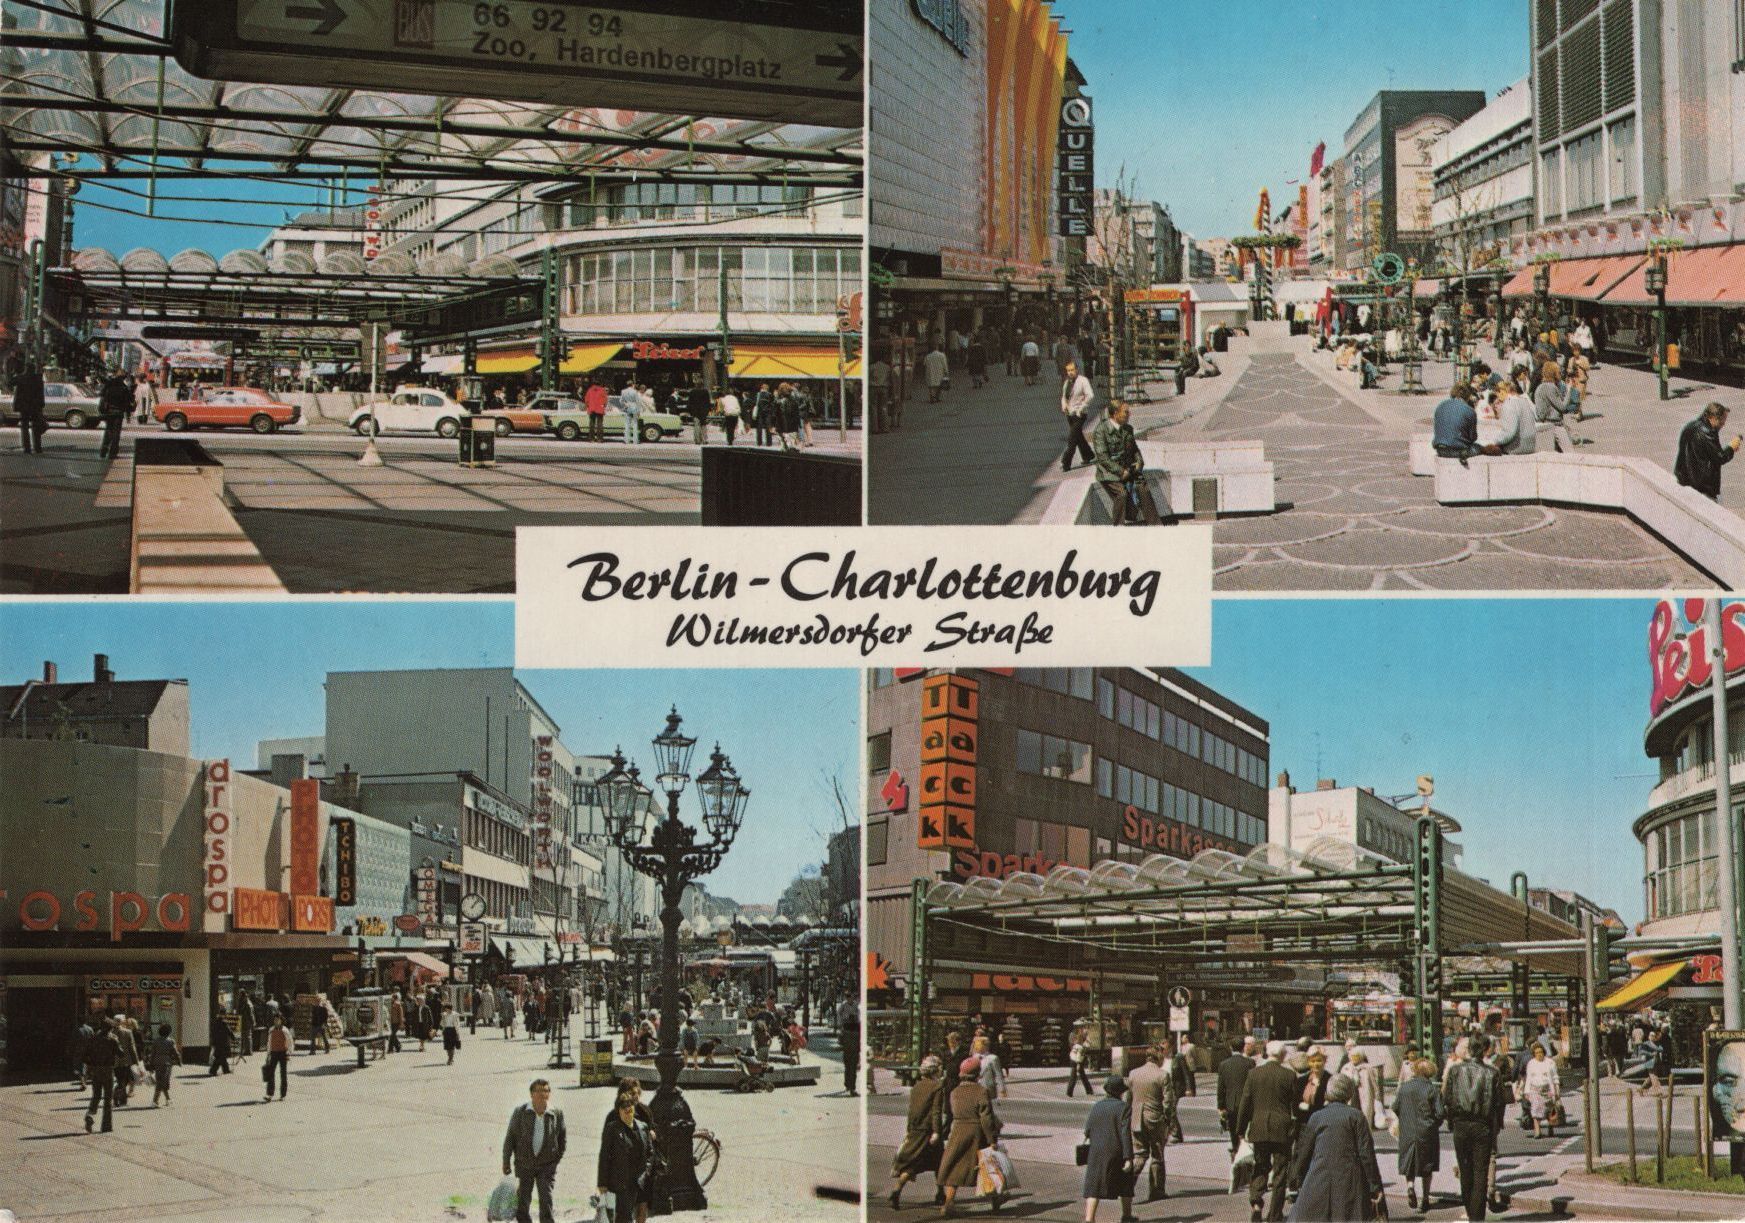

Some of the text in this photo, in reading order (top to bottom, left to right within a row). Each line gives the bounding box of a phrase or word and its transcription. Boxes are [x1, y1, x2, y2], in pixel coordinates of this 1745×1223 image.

[472, 4, 623, 37] 66 92 94
[471, 31, 782, 80] Zoo, Hardenbergplatz
[1062, 97, 1092, 236] QUELLE
[921, 683, 944, 841] Tack
[948, 684, 979, 843] Tack
[207, 758, 230, 914] drospa
[340, 821, 352, 903] TCHIBO
[1122, 804, 1237, 855] Sparka
[0, 890, 191, 941] ospa
[423, 869, 435, 923] OMEGA
